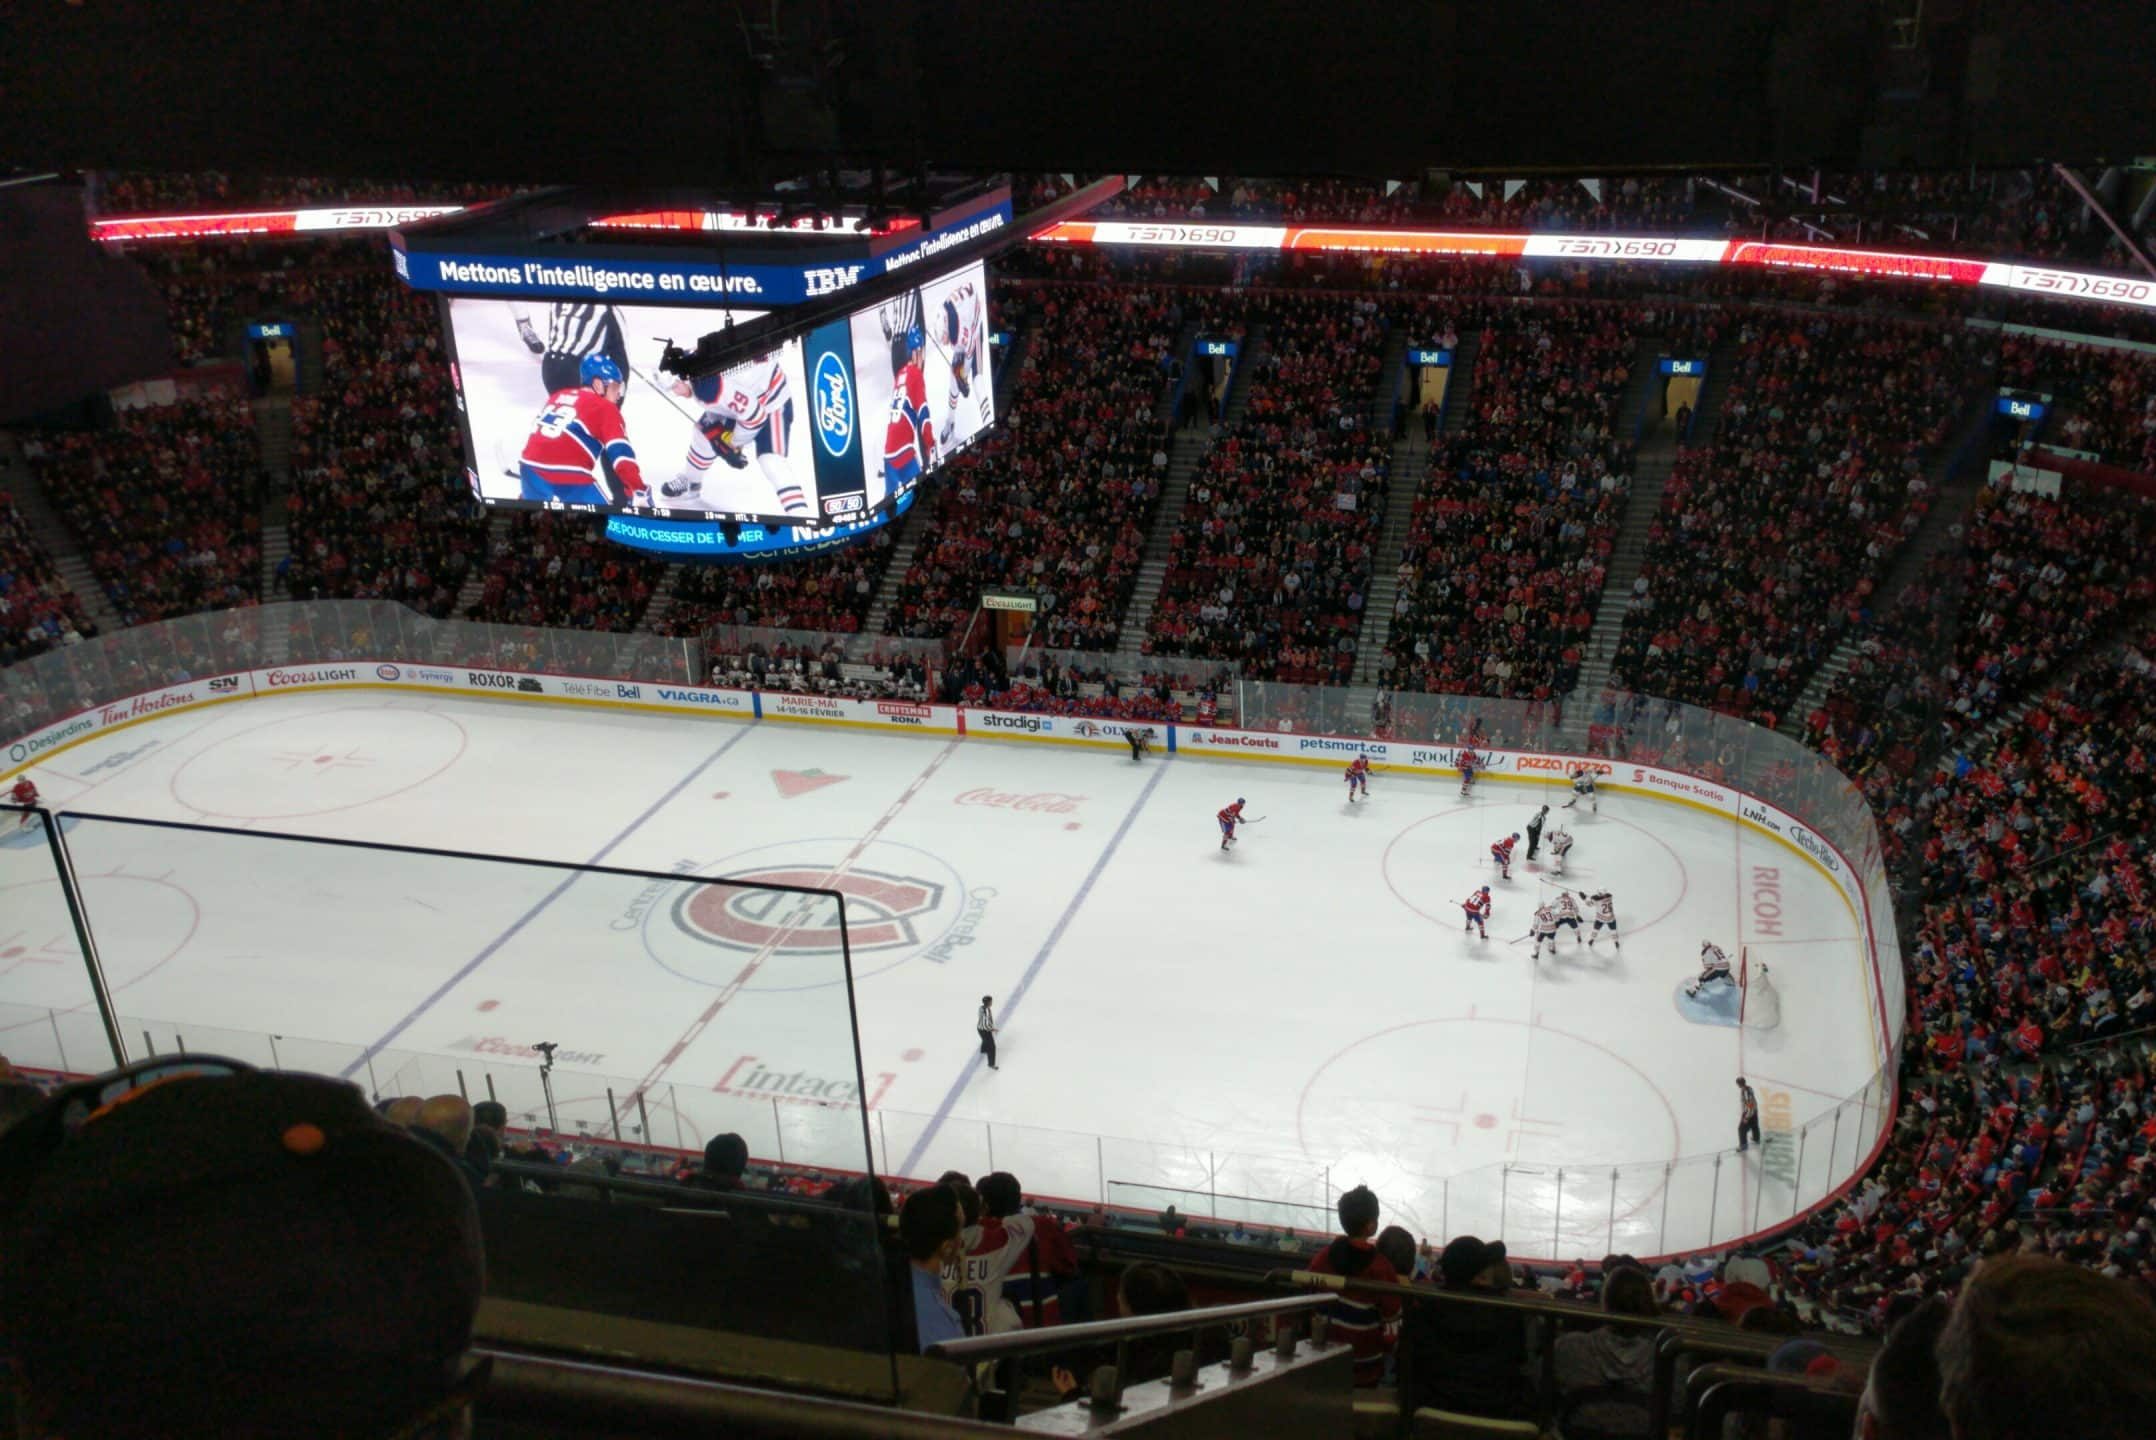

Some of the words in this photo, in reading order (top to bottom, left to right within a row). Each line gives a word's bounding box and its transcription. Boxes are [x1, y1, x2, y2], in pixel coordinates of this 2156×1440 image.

[439, 261, 521, 284] Mettons
[524, 263, 655, 293] l'intelligence
[658, 273, 686, 291] en
[804, 266, 861, 297] IBM
[261, 325, 281, 336] Bell
[1208, 343, 1226, 354] Bell
[1420, 352, 1438, 363] Bell
[1671, 361, 1692, 373] Bell
[728, 391, 750, 415] 29
[819, 372, 848, 437] Ford
[2010, 401, 2031, 416] Bell
[621, 523, 649, 540] POUR
[650, 529, 696, 544] CESSER
[697, 532, 716, 544] DE
[717, 530, 764, 545] FMER
[208, 676, 239, 690] SN
[267, 669, 316, 686] Coors
[318, 669, 357, 681] LIGHT
[419, 670, 453, 682] Synergy
[468, 672, 516, 690] ROXOR
[588, 683, 611, 698] Fibe
[617, 684, 641, 699] Bell
[657, 689, 740, 706] VIAGRA.ca
[97, 705, 130, 726] Tim
[130, 691, 195, 716] Hortons
[878, 703, 931, 717] CRAFTSMAN
[890, 715, 922, 725] RONA
[983, 713, 1041, 732] stradigi
[28, 719, 93, 753] Desjardins
[1208, 733, 1240, 747] Jean
[1240, 736, 1280, 749] Coutu
[1300, 738, 1388, 754] petsmart.ca
[1516, 755, 1563, 771] pizza
[1565, 759, 1613, 775] pizza
[1649, 774, 1691, 792] Banque
[1693, 784, 1724, 802] Scotia
[1743, 806, 1781, 833] LNH.com
[1752, 865, 1783, 937] RICOH
